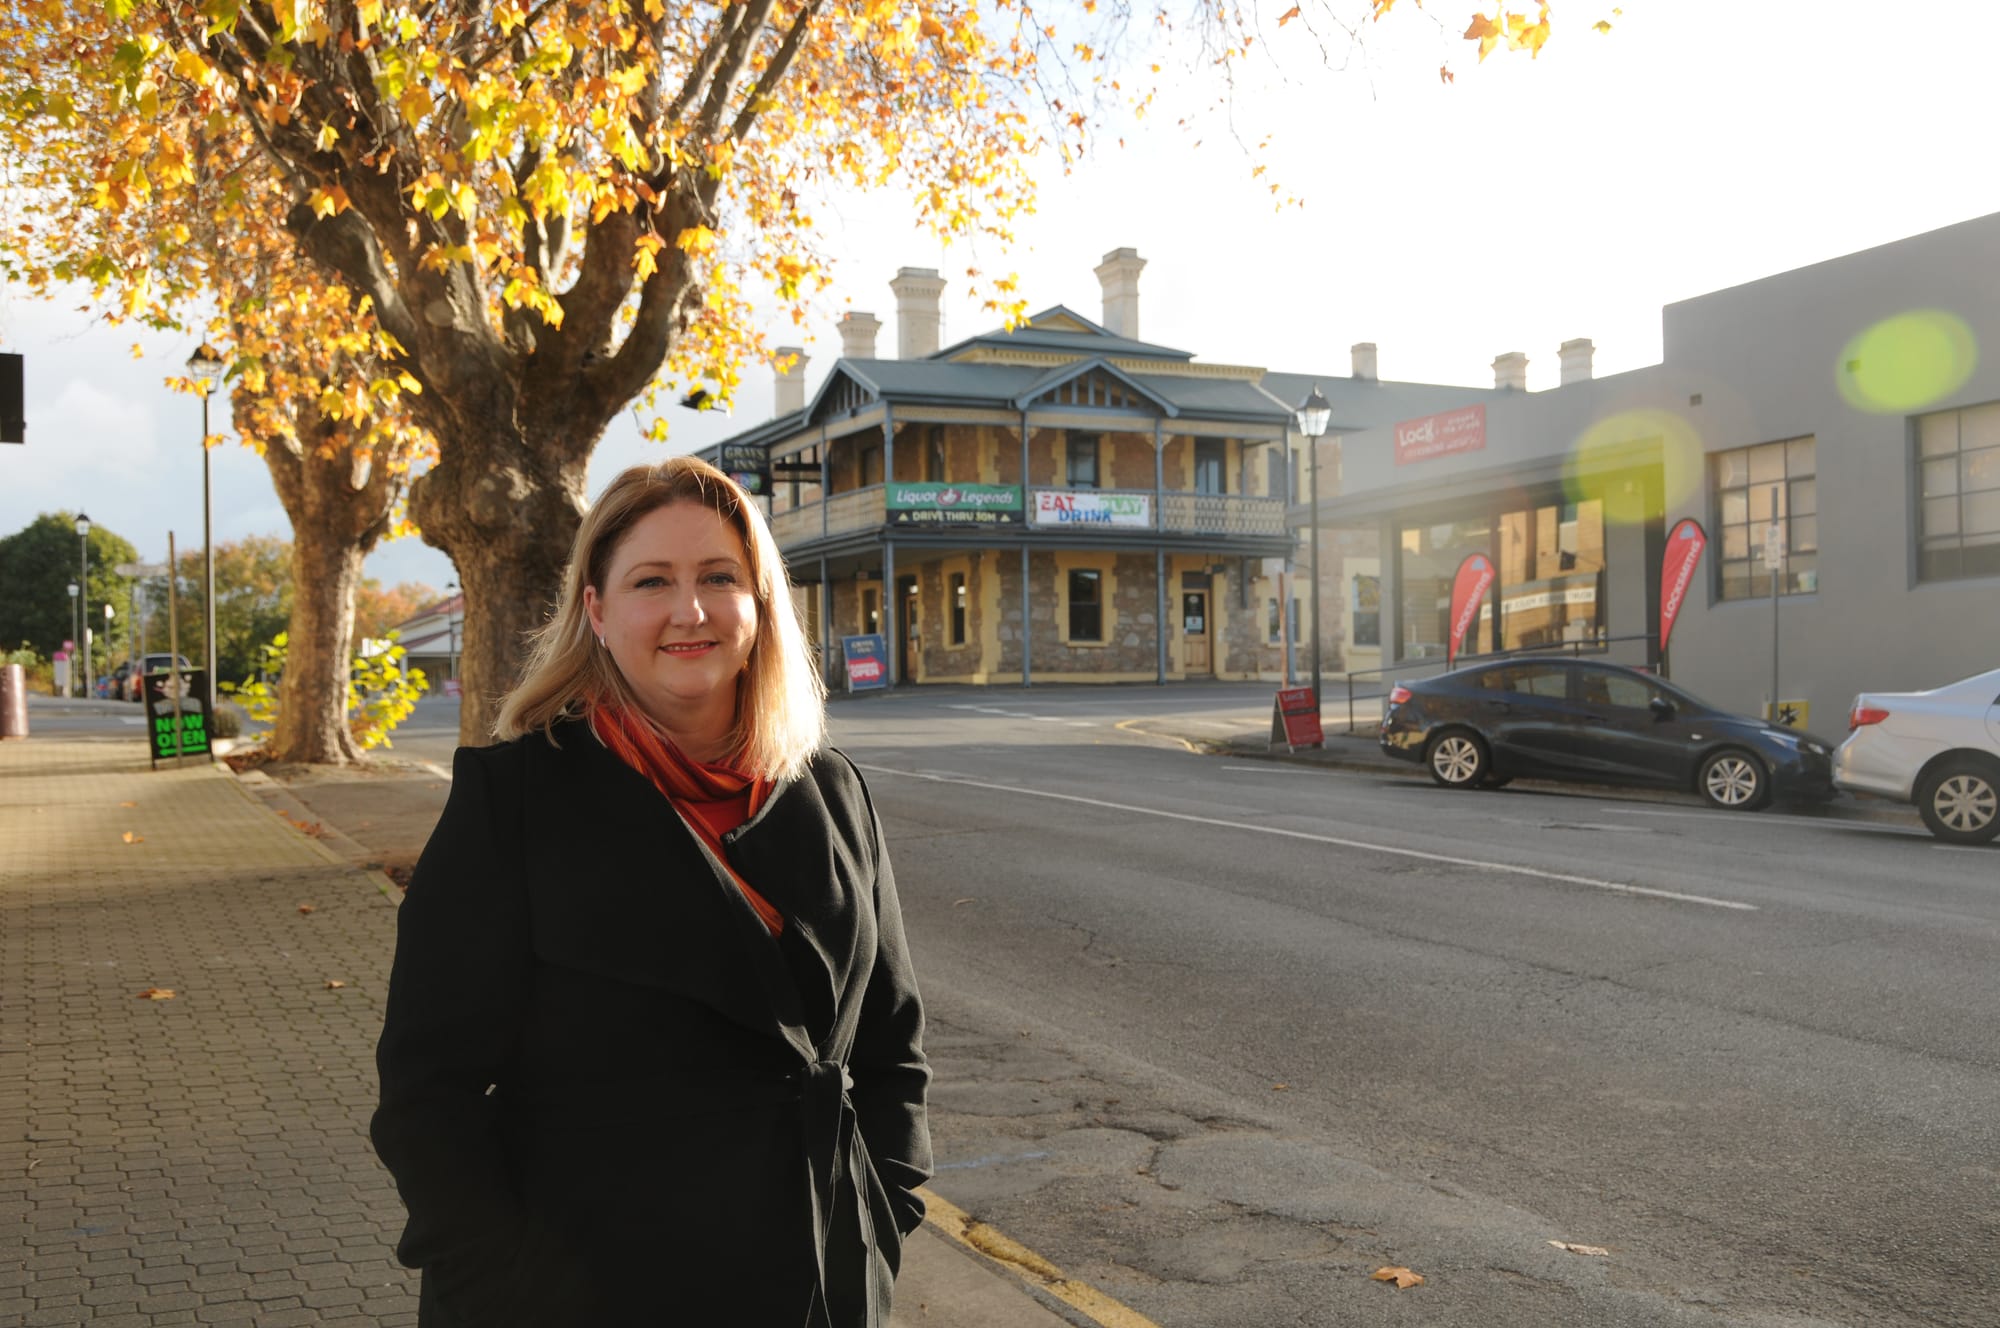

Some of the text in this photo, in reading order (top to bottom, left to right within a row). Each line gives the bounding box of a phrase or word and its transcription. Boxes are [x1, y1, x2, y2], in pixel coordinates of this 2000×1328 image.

[724, 446, 765, 460] GRAYS
[733, 459, 757, 470] INN
[896, 488, 1013, 505] Liquor Legends
[1040, 495, 1075, 511] EAT
[1101, 499, 1141, 513] PLAY
[912, 511, 944, 522] DRIVE
[946, 511, 974, 522] THRU
[1058, 508, 1112, 523] DRINK
[1664, 540, 1702, 618] LOCKSMITHS
